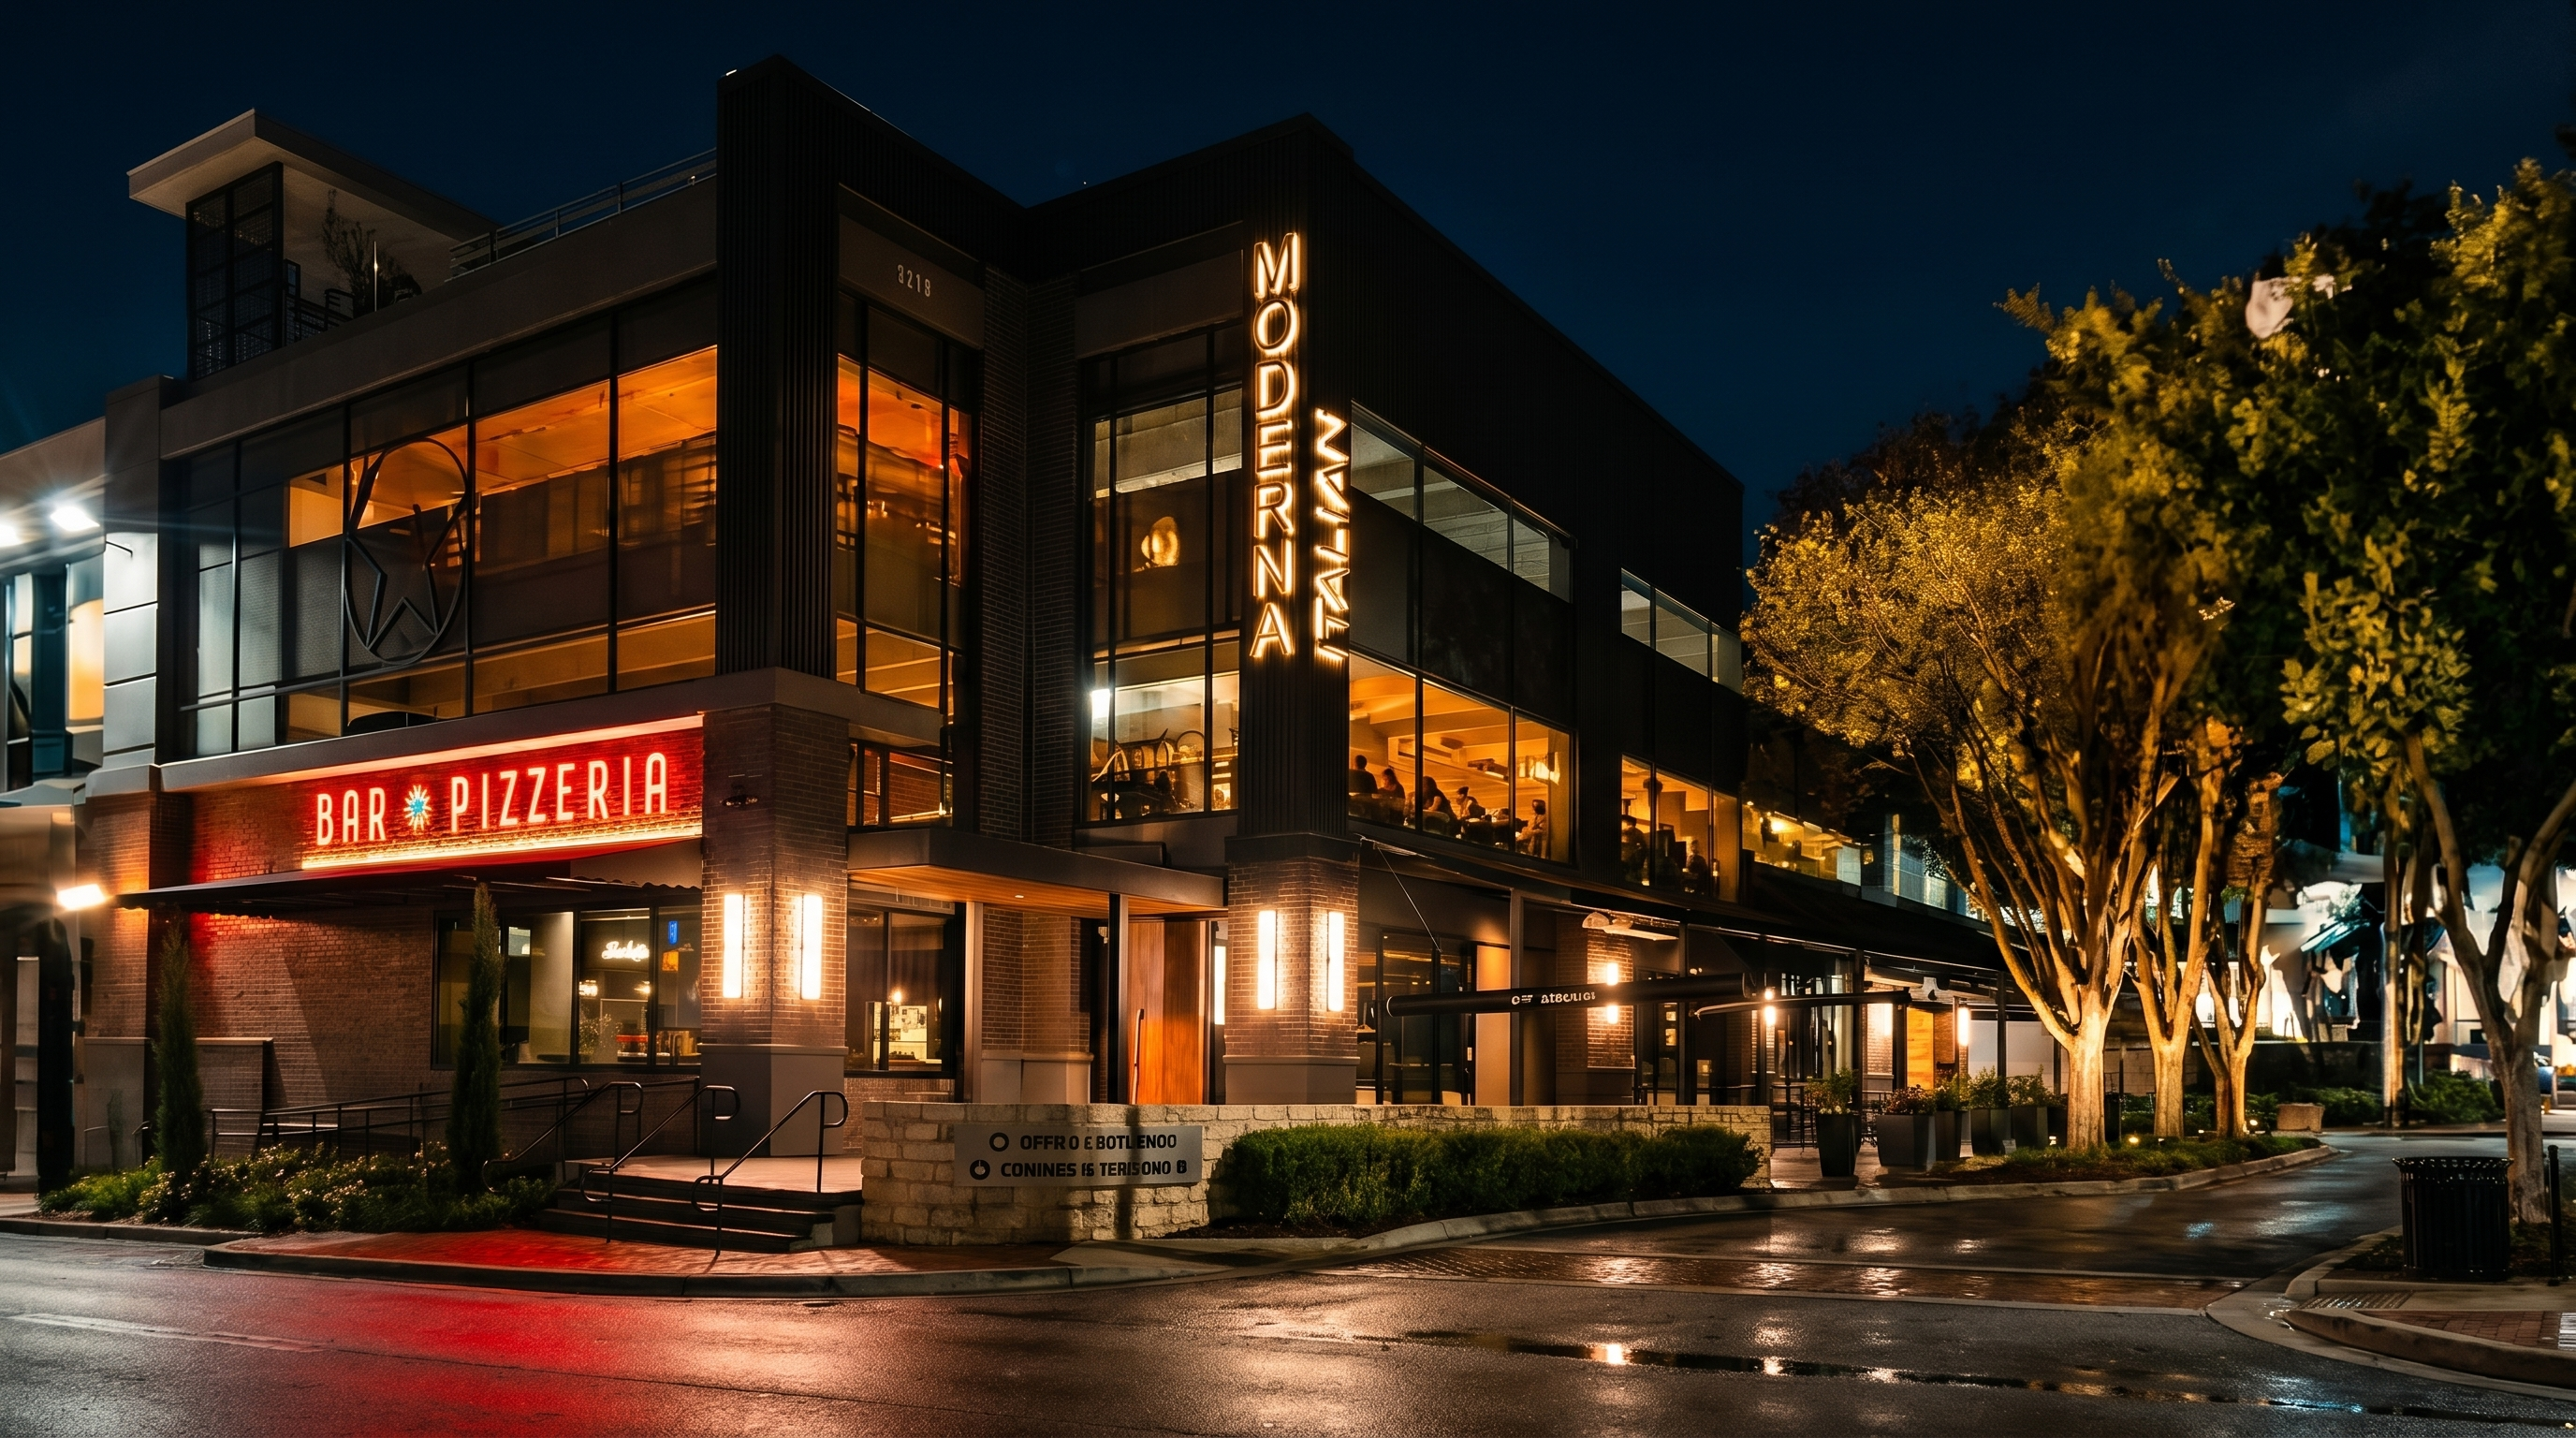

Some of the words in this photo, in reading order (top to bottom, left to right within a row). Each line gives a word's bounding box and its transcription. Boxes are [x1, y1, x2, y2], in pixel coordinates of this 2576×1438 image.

[1251, 232, 1300, 658] MODERNA
[315, 787, 386, 846] BAR
[450, 753, 667, 833] PIZZERIA
[1001, 1162, 1076, 1178] CONINES
